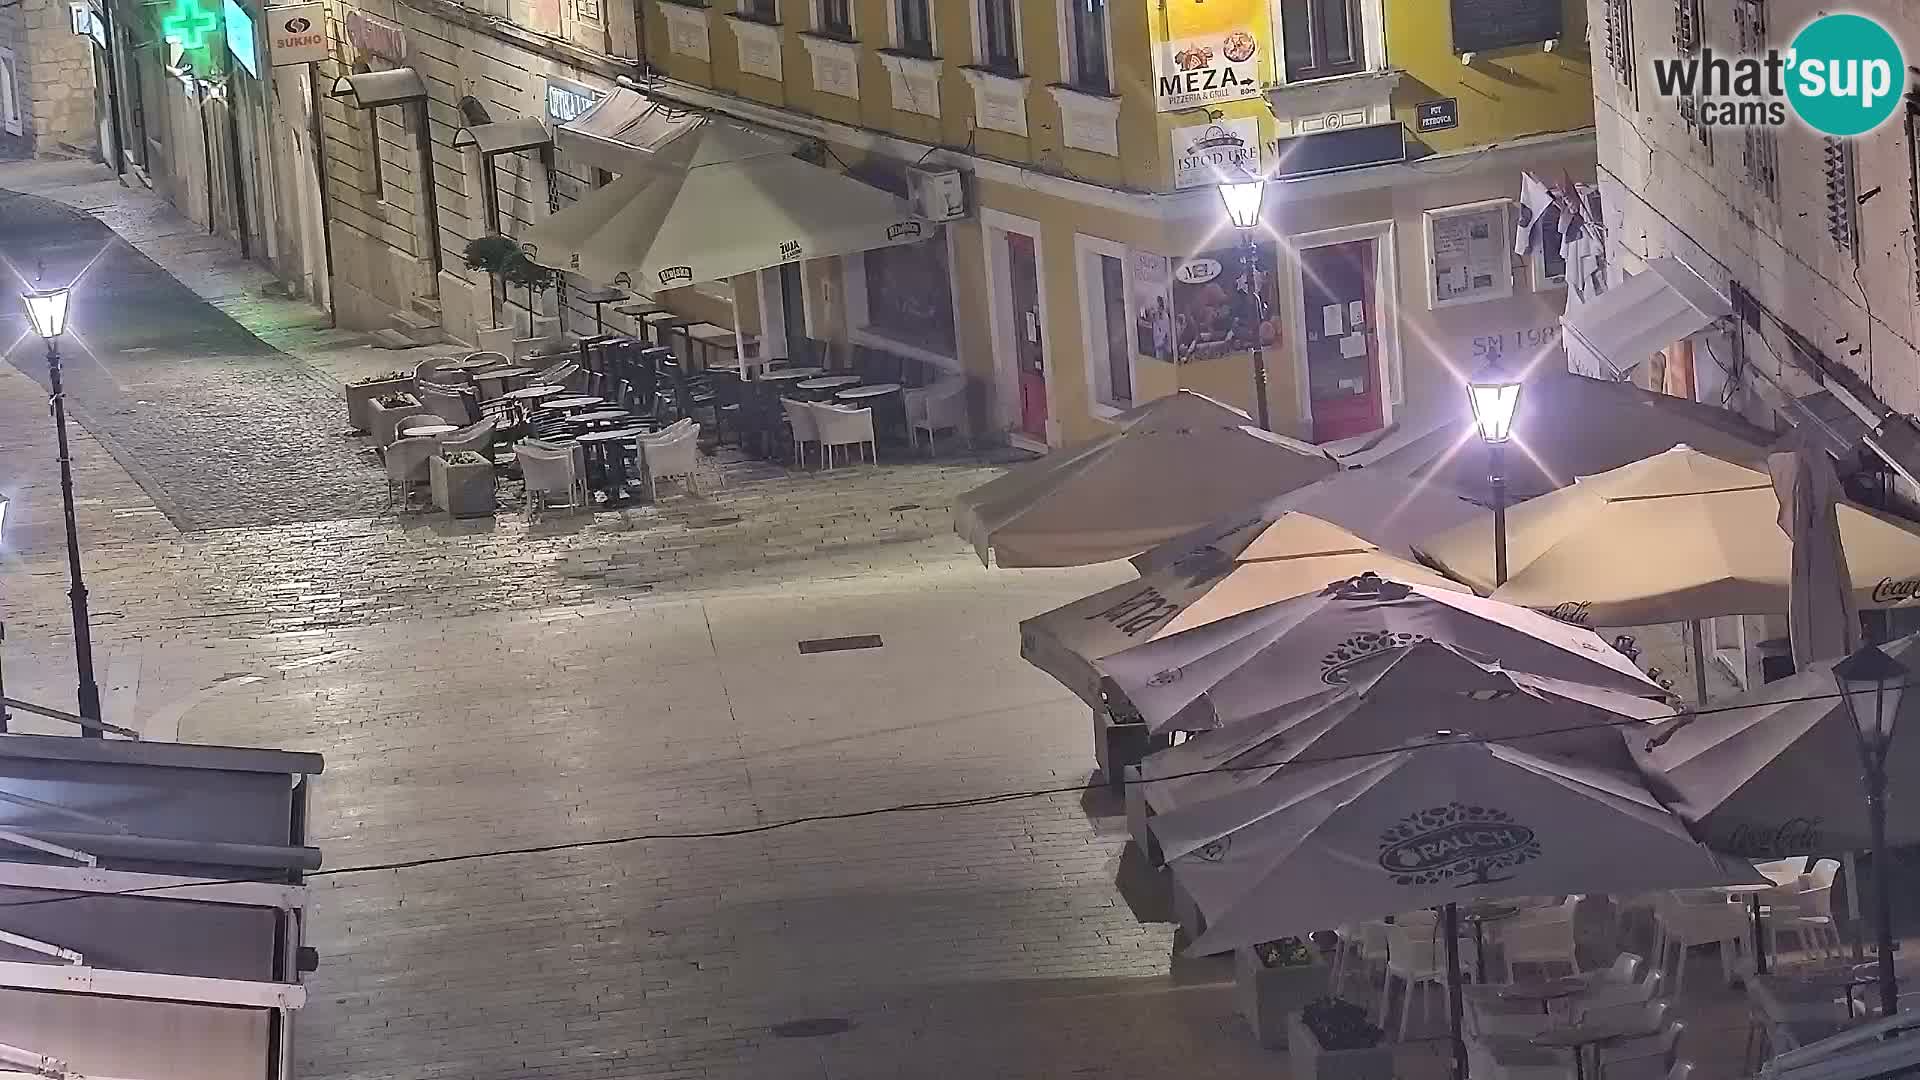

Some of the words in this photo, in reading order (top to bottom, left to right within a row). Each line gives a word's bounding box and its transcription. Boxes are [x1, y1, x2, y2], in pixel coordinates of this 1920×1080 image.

[1160, 66, 1239, 97] MEZA
[1168, 91, 1202, 105] PIZZERIA
[1209, 87, 1230, 99] GRILL
[1177, 151, 1223, 171] ISPOD
